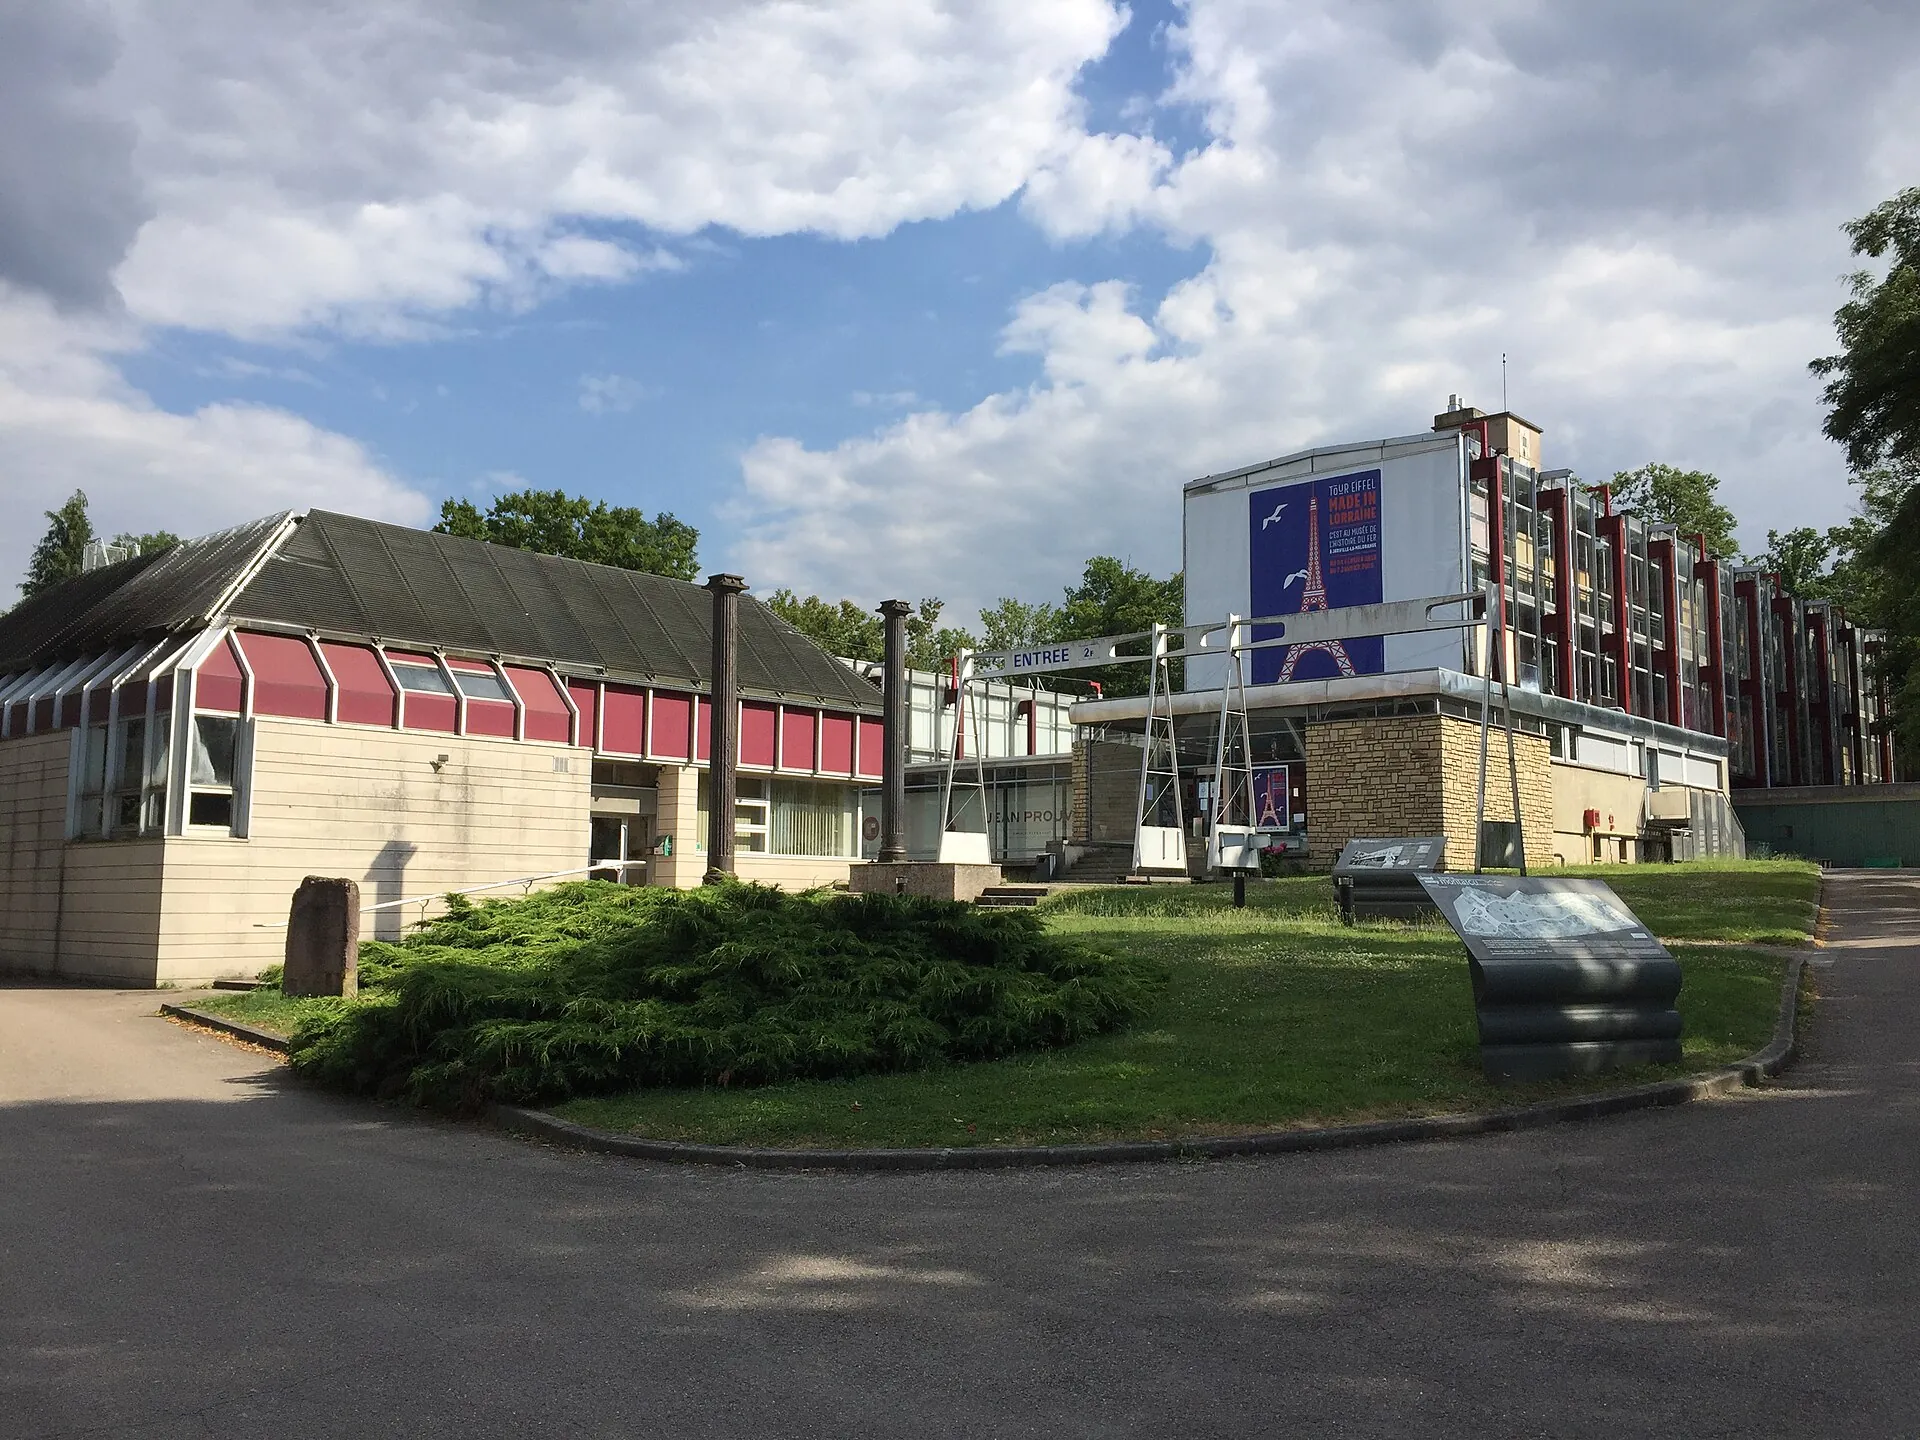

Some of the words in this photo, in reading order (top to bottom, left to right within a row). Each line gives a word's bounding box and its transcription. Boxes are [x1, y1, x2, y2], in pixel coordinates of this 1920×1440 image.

[1329, 483, 1349, 496] TOUR
[1351, 478, 1376, 493] EIFFEL
[1329, 493, 1360, 512] MADE
[1363, 490, 1376, 505] IN
[1329, 506, 1376, 525] LORRAINE
[1351, 525, 1369, 536] MUSÉE
[1370, 524, 1376, 533] DE
[1358, 535, 1366, 544] DU
[1367, 533, 1376, 542] FER
[1014, 648, 1069, 667] ENTREE
[987, 811, 1019, 823] JEAN
